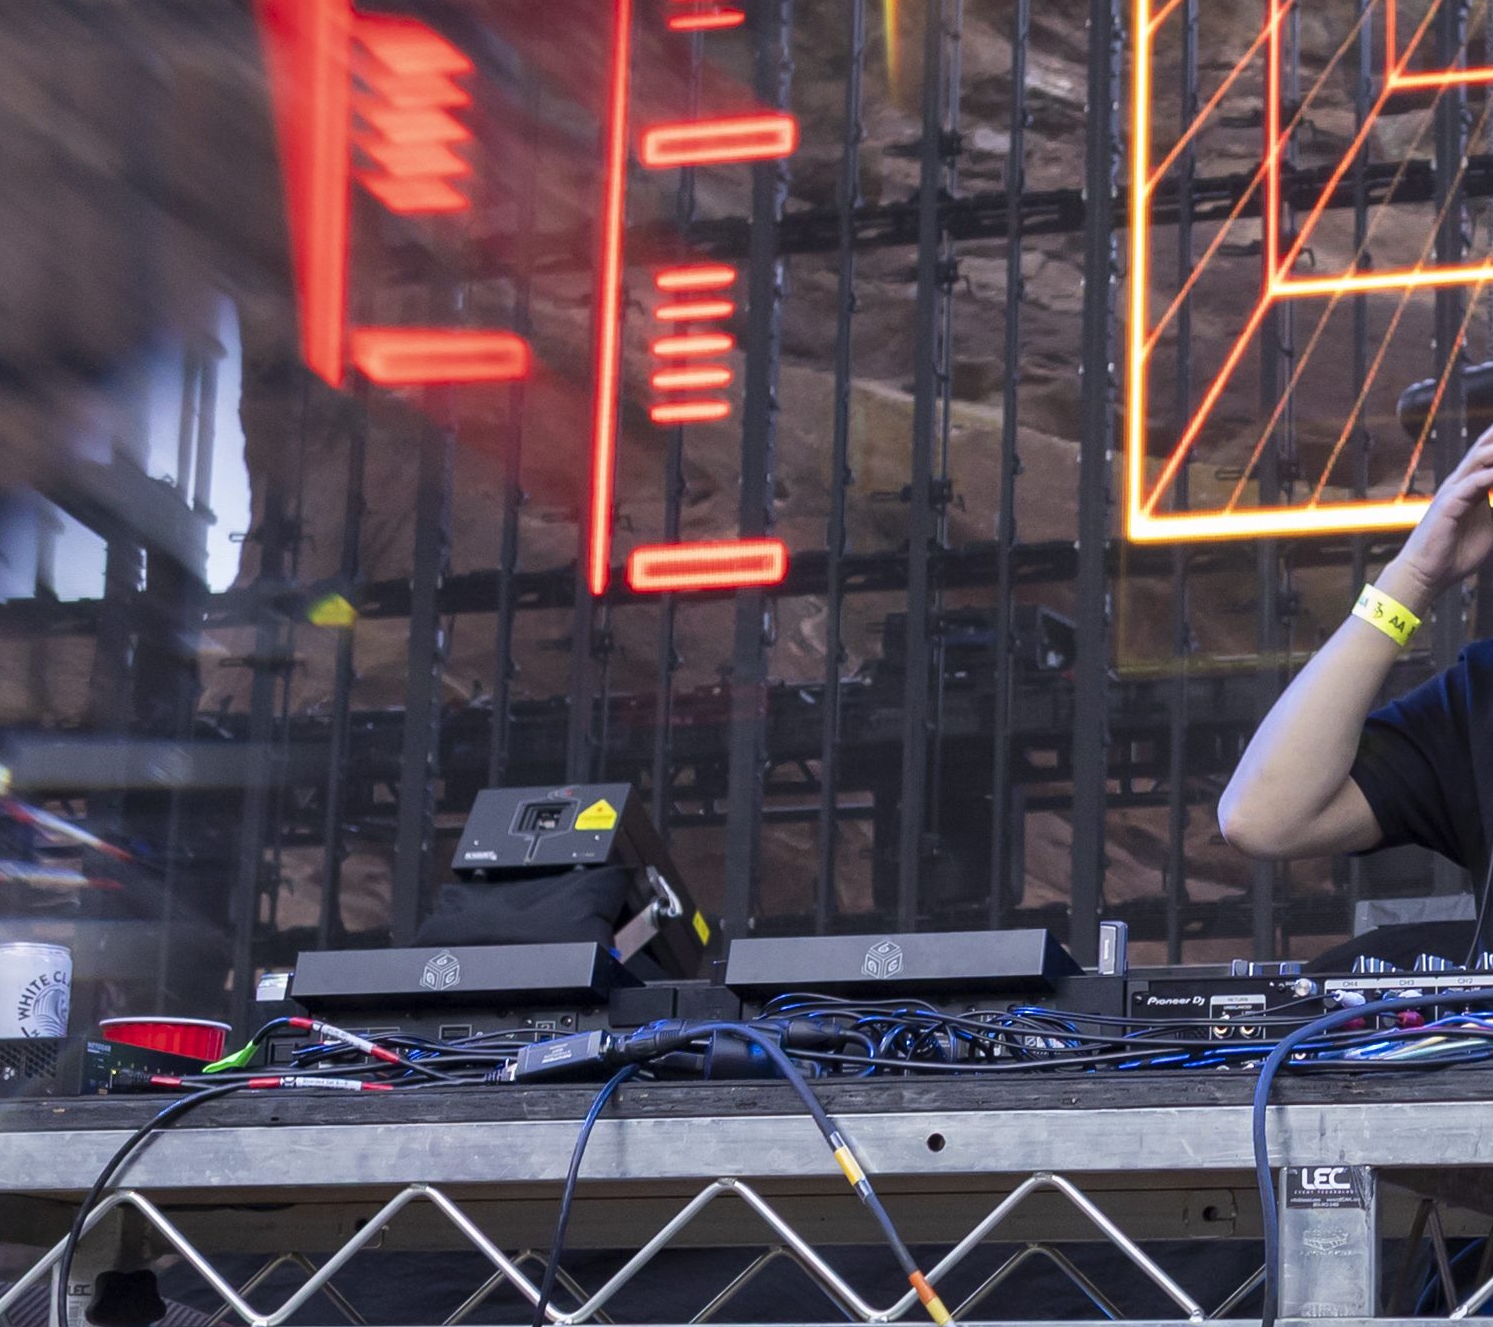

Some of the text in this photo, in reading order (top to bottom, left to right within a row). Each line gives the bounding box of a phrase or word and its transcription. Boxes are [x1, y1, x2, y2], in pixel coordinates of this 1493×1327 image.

[17, 971, 71, 1021] WHITE CL
[1147, 996, 1191, 1005] Pioneer
[1301, 1167, 1351, 1190] LEC
[67, 1284, 92, 1297] LEC
